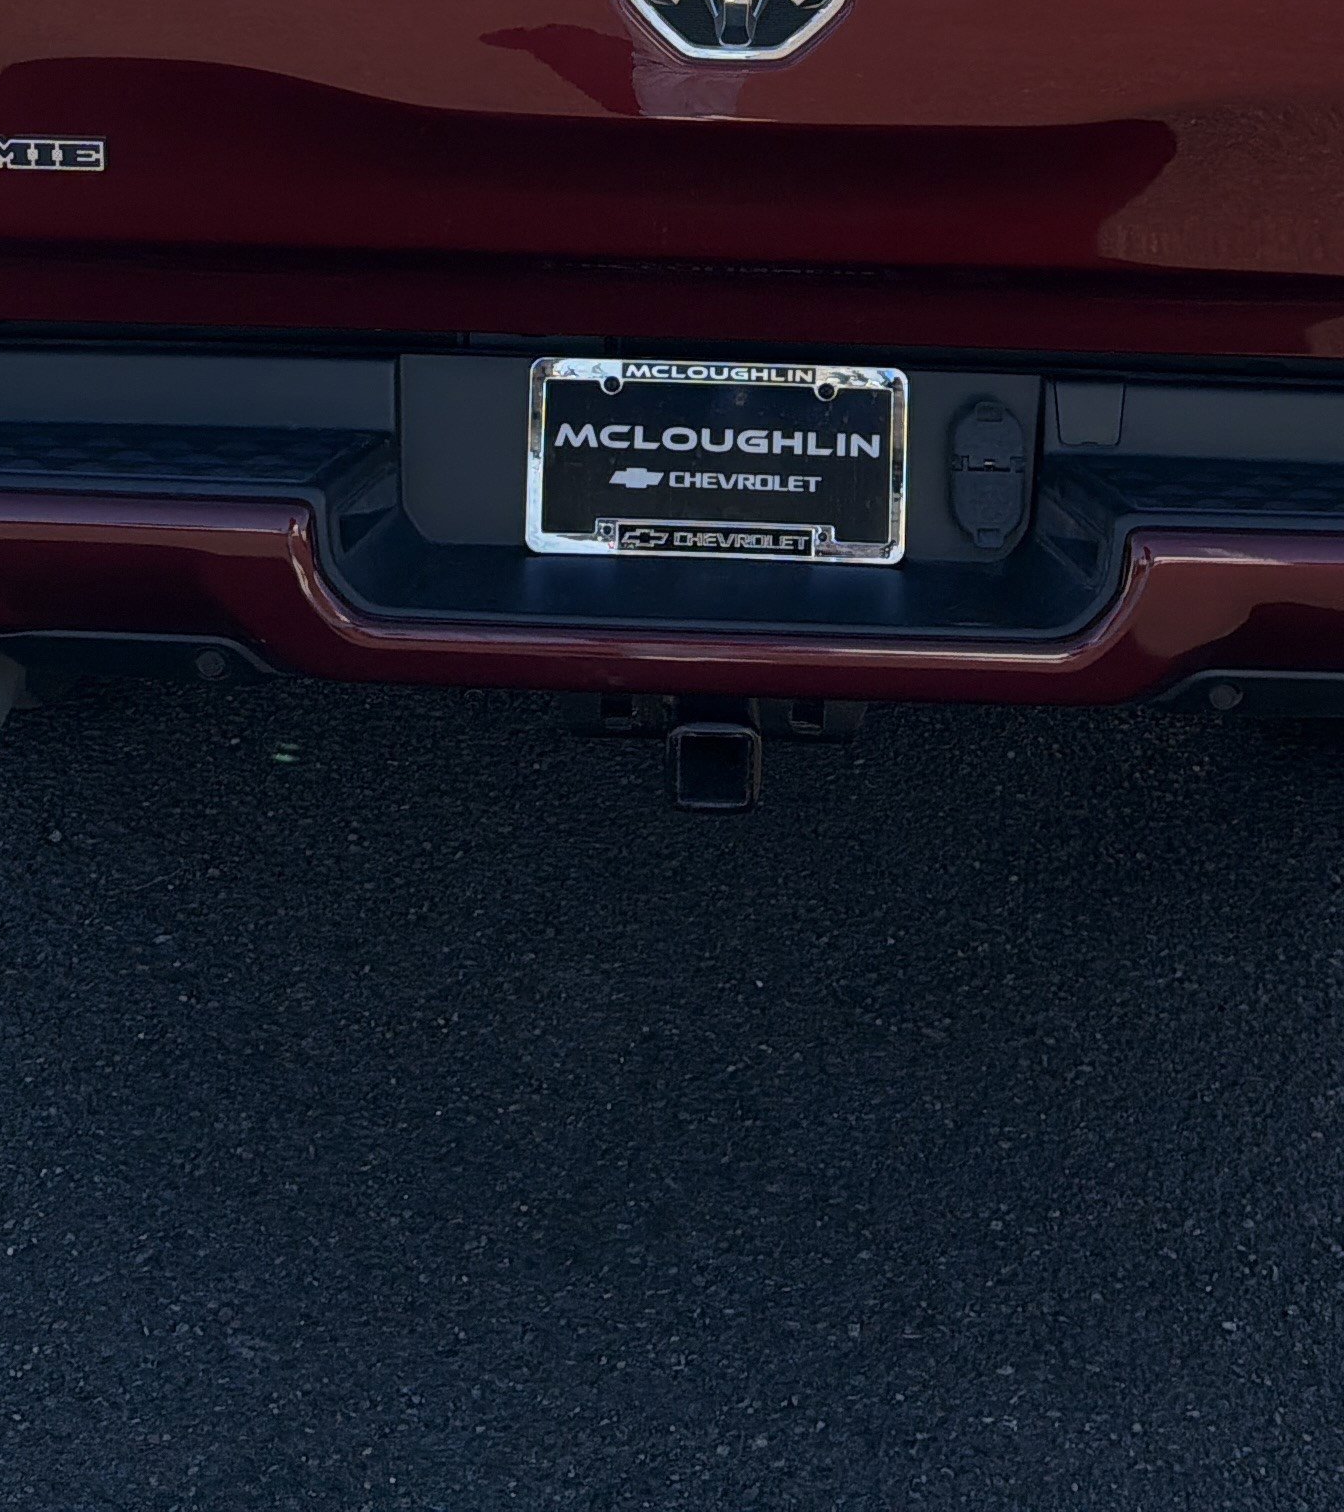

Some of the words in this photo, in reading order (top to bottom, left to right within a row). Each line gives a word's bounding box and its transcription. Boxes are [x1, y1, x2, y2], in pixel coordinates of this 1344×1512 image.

[624, 364, 813, 383] MCLOUGHLIN
[554, 423, 881, 458] MCLOUGHLIN
[668, 470, 822, 493] CHEVROLET
[672, 531, 810, 550] CHEVROLET
